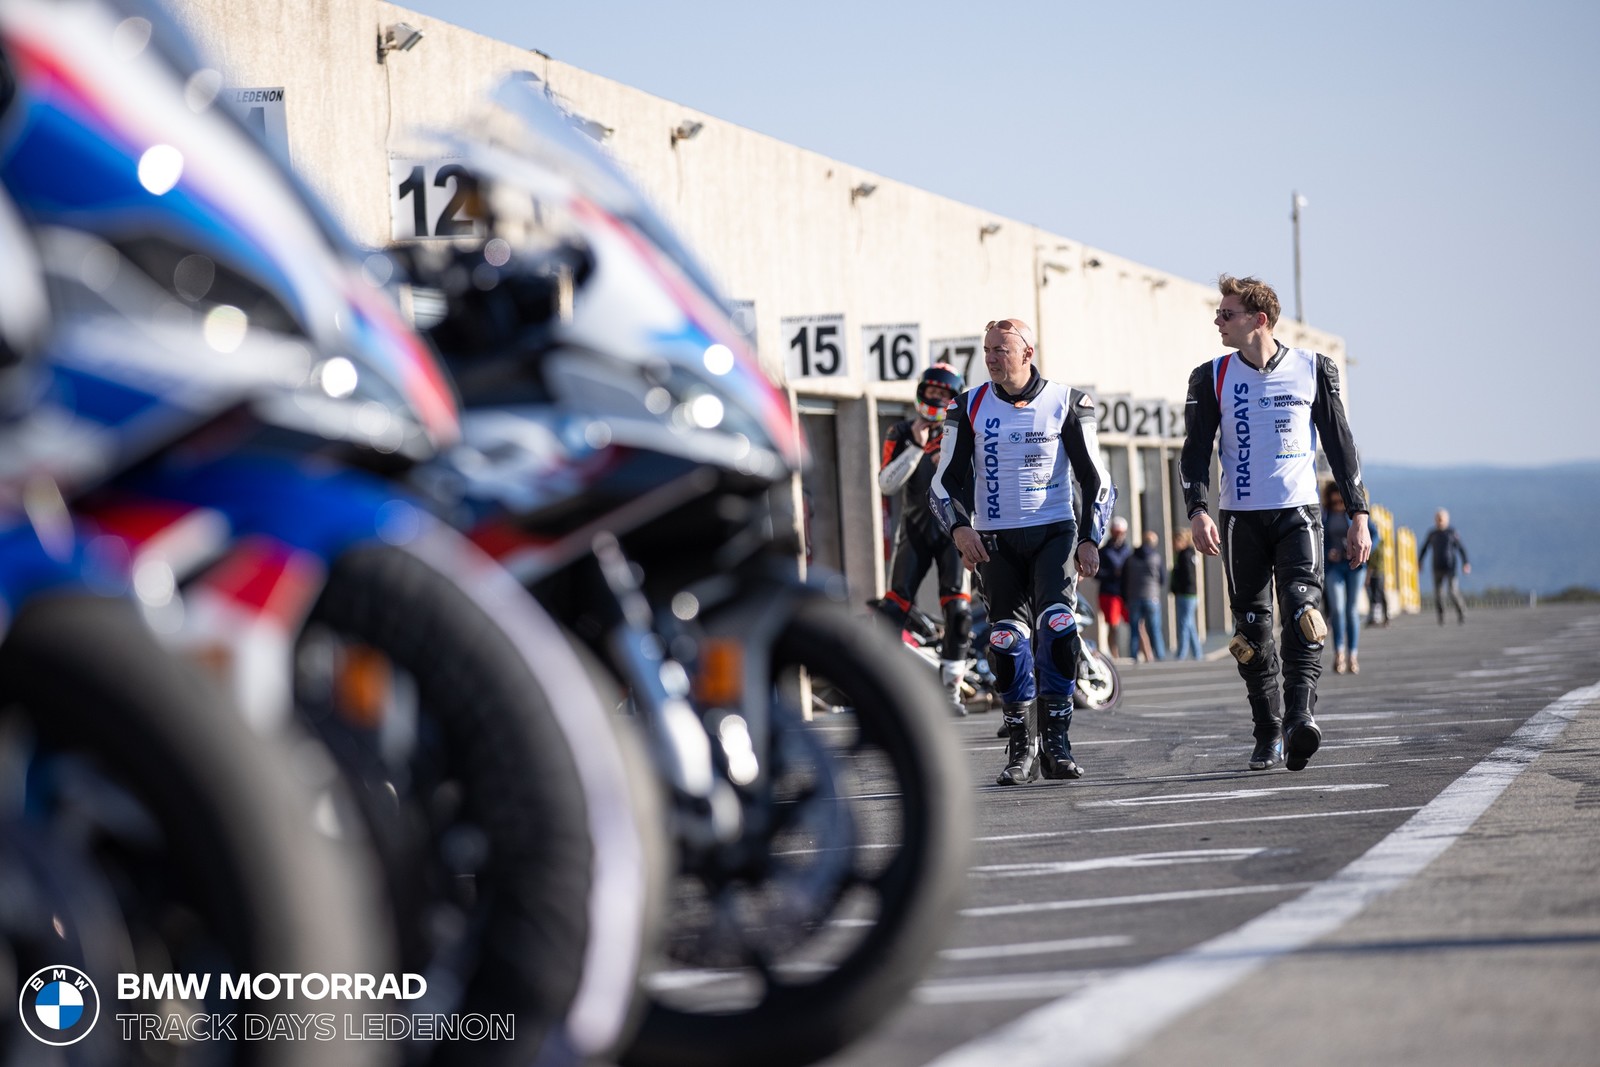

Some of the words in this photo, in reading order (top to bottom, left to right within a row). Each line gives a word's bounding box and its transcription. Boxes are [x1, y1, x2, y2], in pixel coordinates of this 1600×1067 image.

[236, 90, 284, 103] LEDENON
[398, 163, 475, 237] 12
[790, 325, 841, 376] 15
[869, 333, 915, 381] 16
[1097, 401, 1130, 433] 20
[1135, 406, 1163, 435] 21
[1234, 383, 1250, 500] TRACKDAYS
[984, 417, 1001, 521] RACKDAYS
